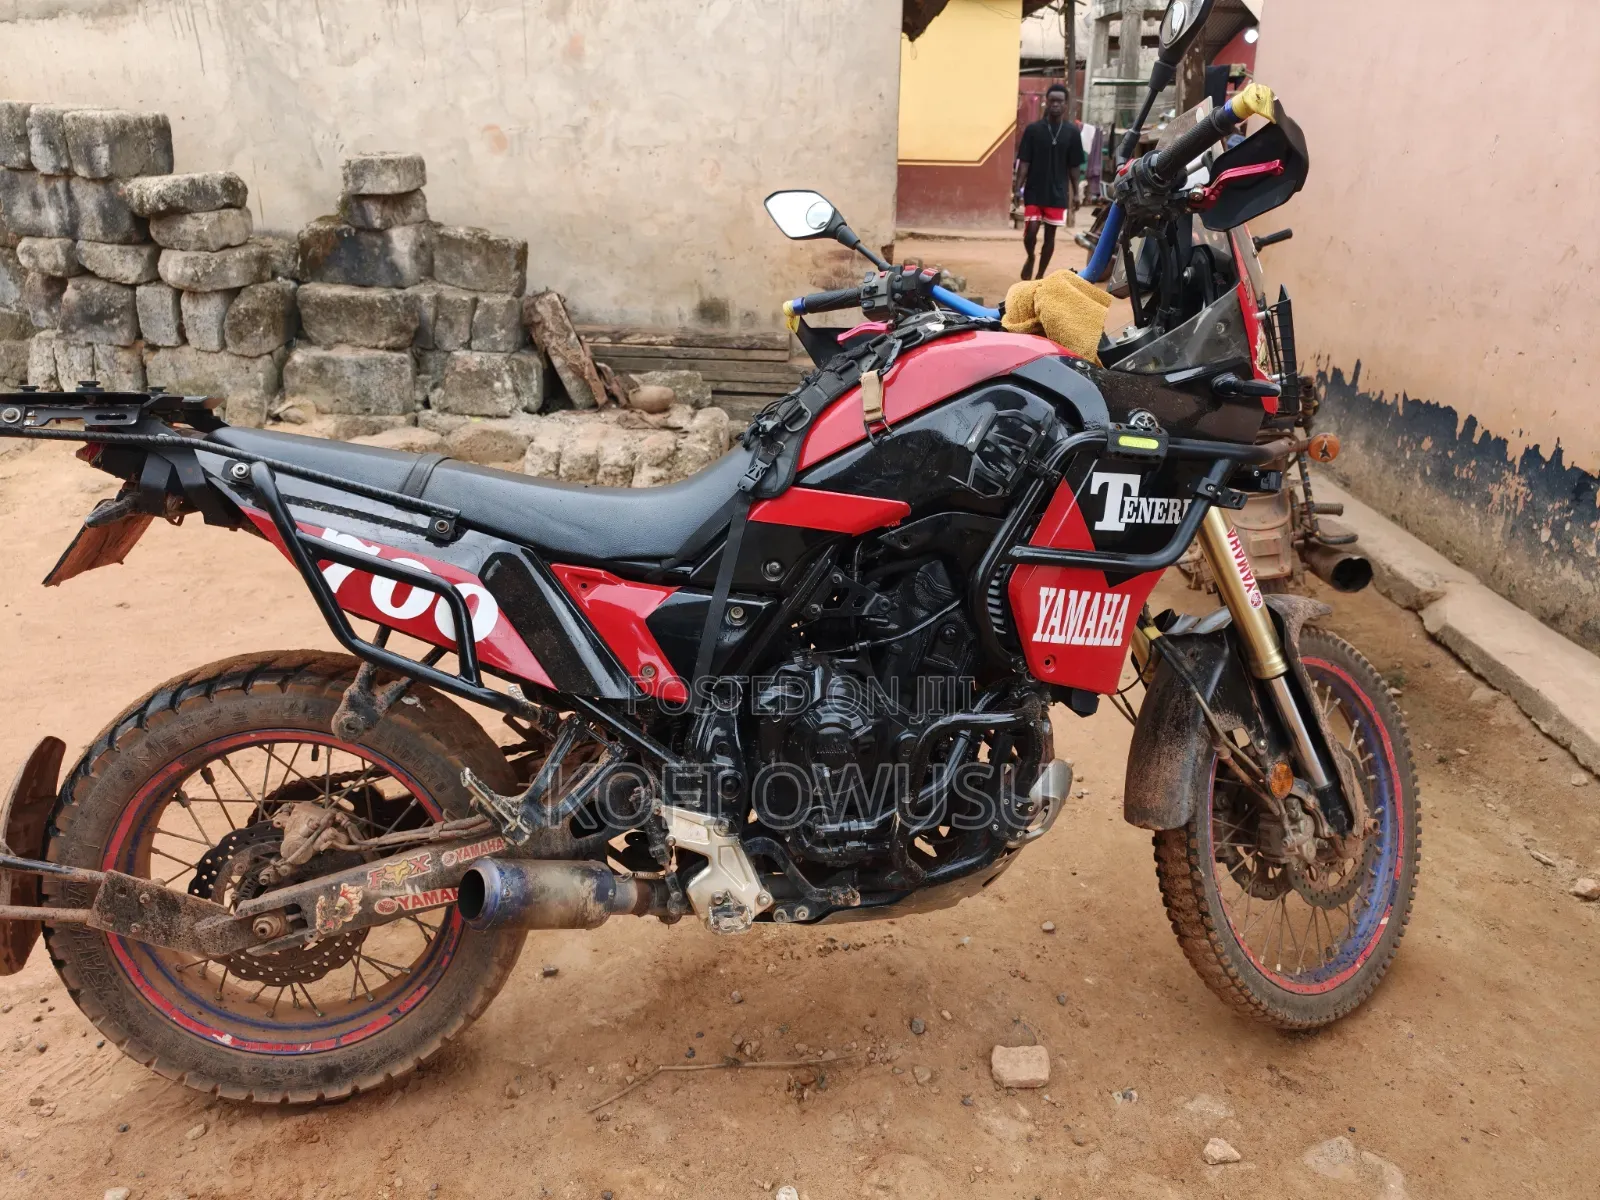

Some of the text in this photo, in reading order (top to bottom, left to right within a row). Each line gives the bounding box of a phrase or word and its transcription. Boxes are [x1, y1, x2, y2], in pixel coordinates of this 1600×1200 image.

[321, 527, 499, 643] 700
[1227, 526, 1256, 593] YAMAHA
[1032, 587, 1131, 647] YAMAHA
[457, 838, 505, 862] YAMAHA
[398, 887, 459, 910] YAMA
